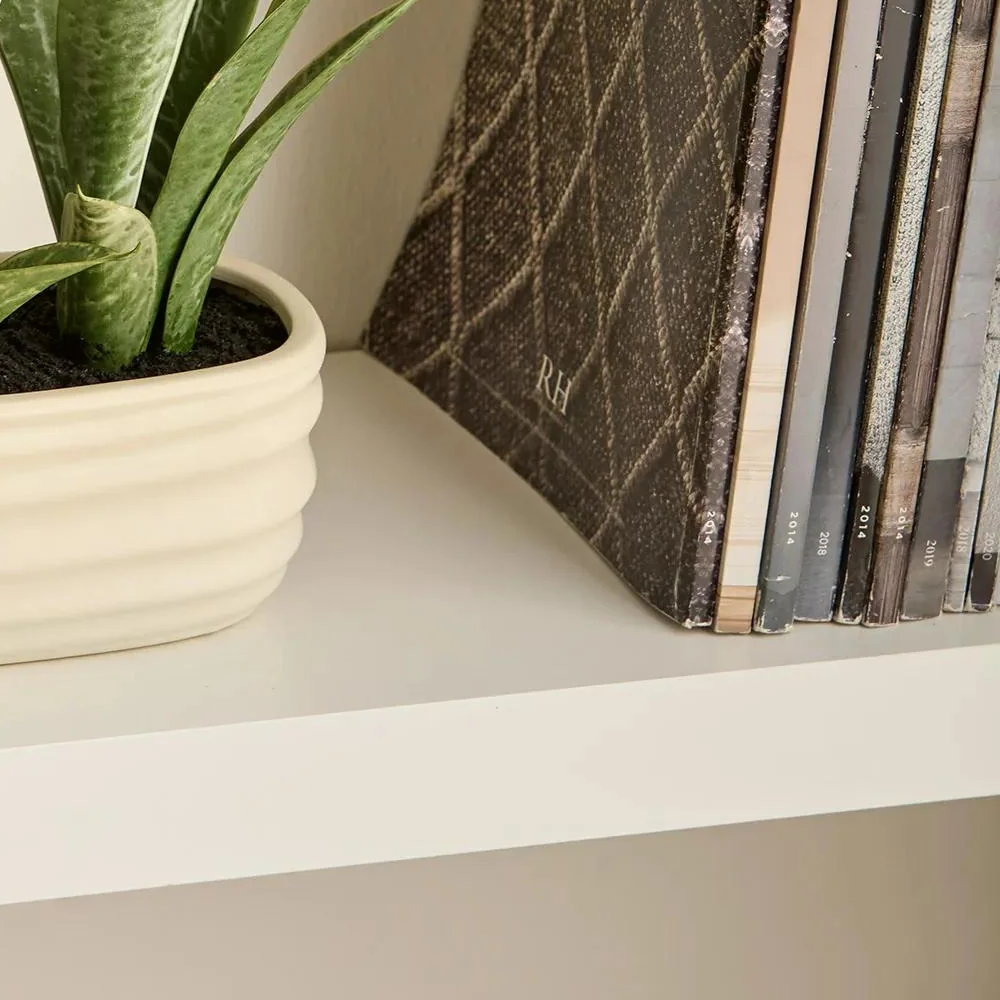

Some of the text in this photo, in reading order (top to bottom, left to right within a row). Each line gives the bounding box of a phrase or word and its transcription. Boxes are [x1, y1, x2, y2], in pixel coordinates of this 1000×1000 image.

[536, 354, 572, 416] RH
[704, 511, 716, 544] 2014
[787, 511, 799, 544] 2014
[857, 505, 871, 539] 2014
[895, 507, 908, 540] 2014
[817, 531, 830, 556] 2018
[923, 540, 937, 567] 2019
[982, 532, 996, 561] 2020
